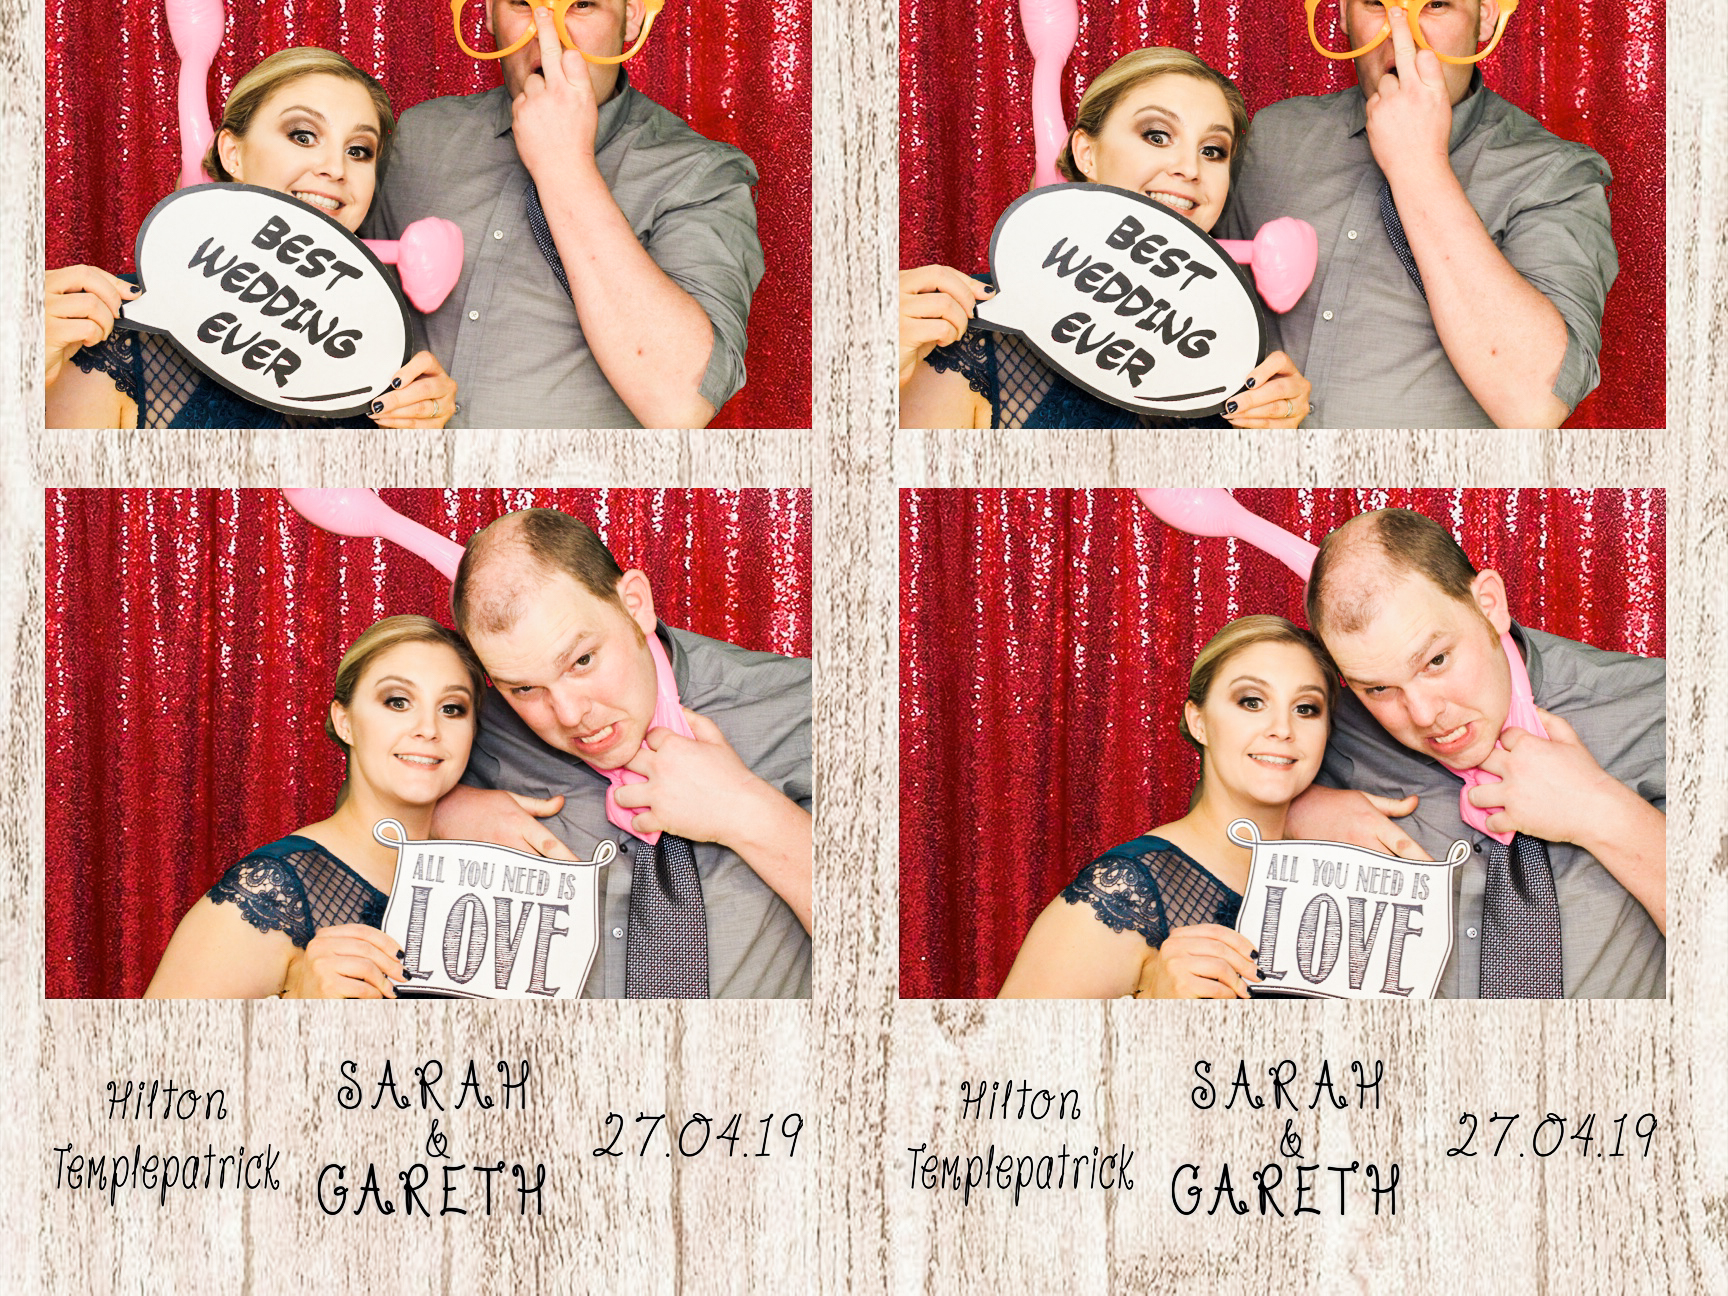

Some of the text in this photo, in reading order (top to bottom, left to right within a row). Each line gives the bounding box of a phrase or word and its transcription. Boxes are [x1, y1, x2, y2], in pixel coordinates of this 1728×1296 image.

[251, 215, 364, 292] BEST
[1105, 215, 1218, 292] BEST
[188, 237, 363, 359] WEDDING
[1042, 237, 1217, 359] WEDDING
[197, 312, 302, 388] EVER
[1051, 312, 1156, 388] EVER
[412, 853, 576, 901] ALL YOU NEED IS
[1266, 853, 1430, 901] ALL YOU NEED IS
[403, 885, 571, 997] LOVE
[1257, 885, 1425, 997] LOVE
